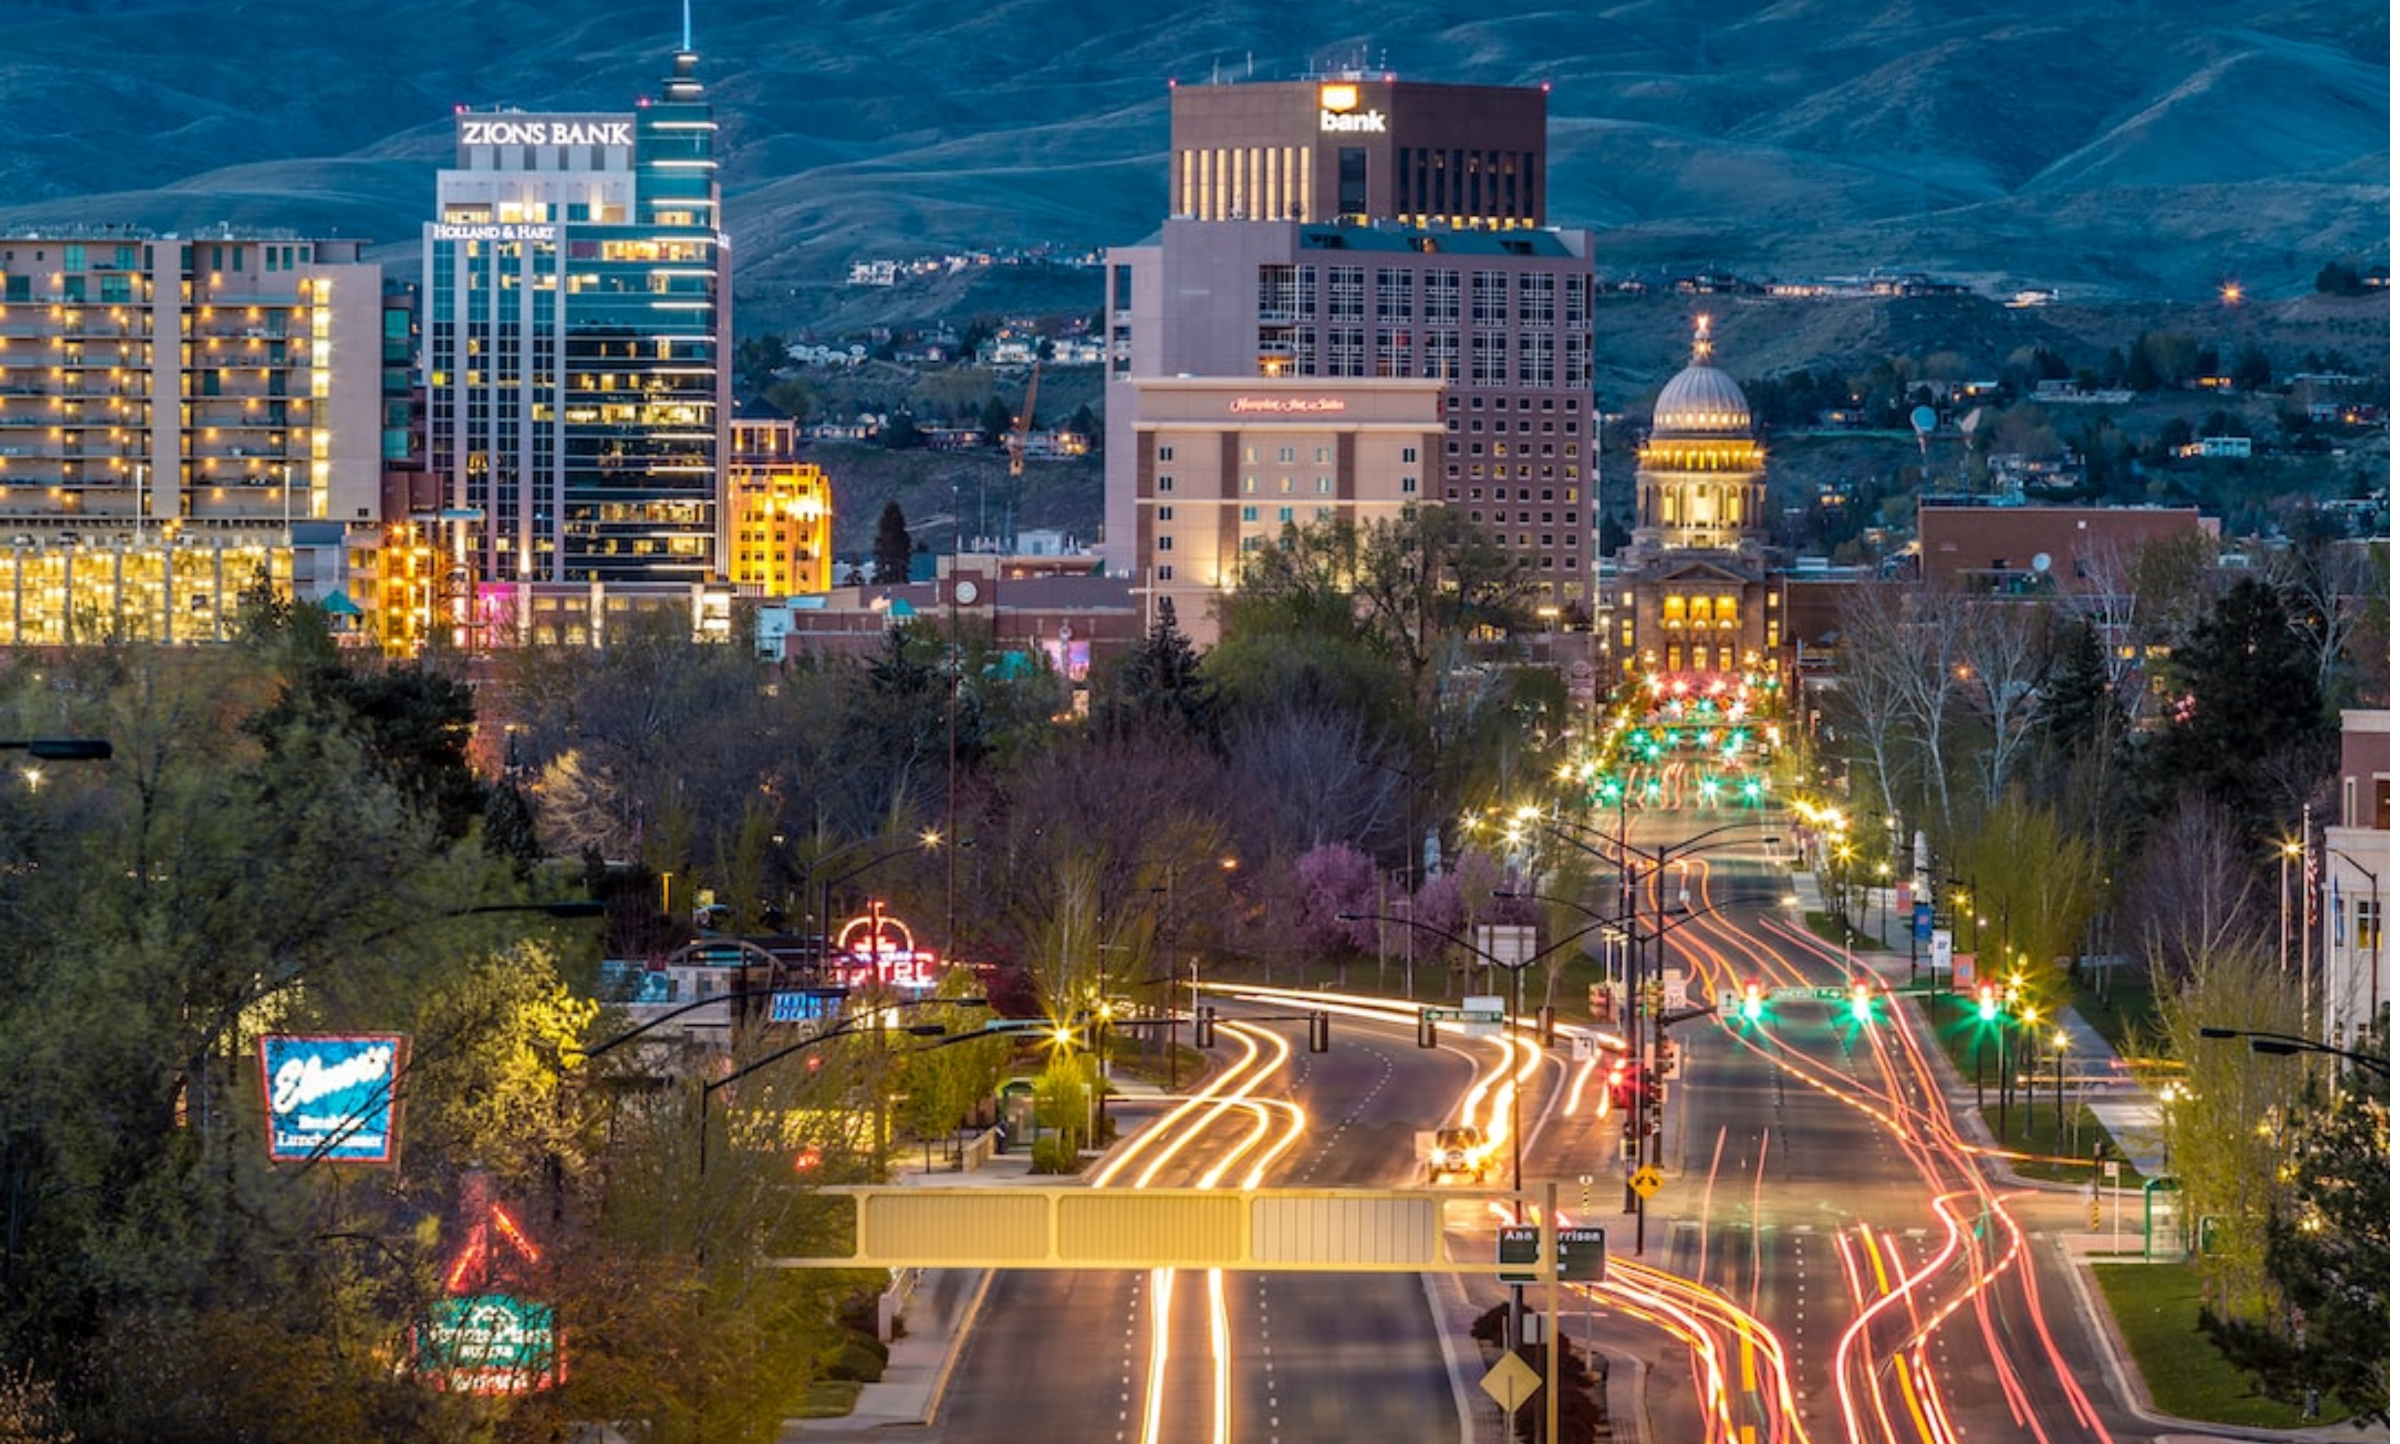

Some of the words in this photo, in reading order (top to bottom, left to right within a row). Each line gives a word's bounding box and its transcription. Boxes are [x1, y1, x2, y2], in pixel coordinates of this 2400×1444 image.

[1321, 109, 1386, 132] bank
[462, 122, 545, 145] ZIONS
[551, 122, 633, 145] BANK
[433, 224, 499, 240] HOLLAND
[502, 225, 515, 239] &
[518, 225, 556, 240] HART
[274, 1046, 391, 1114] Elmer's
[1505, 1231, 1533, 1241] Ann
[1557, 1230, 1600, 1241] rrison
